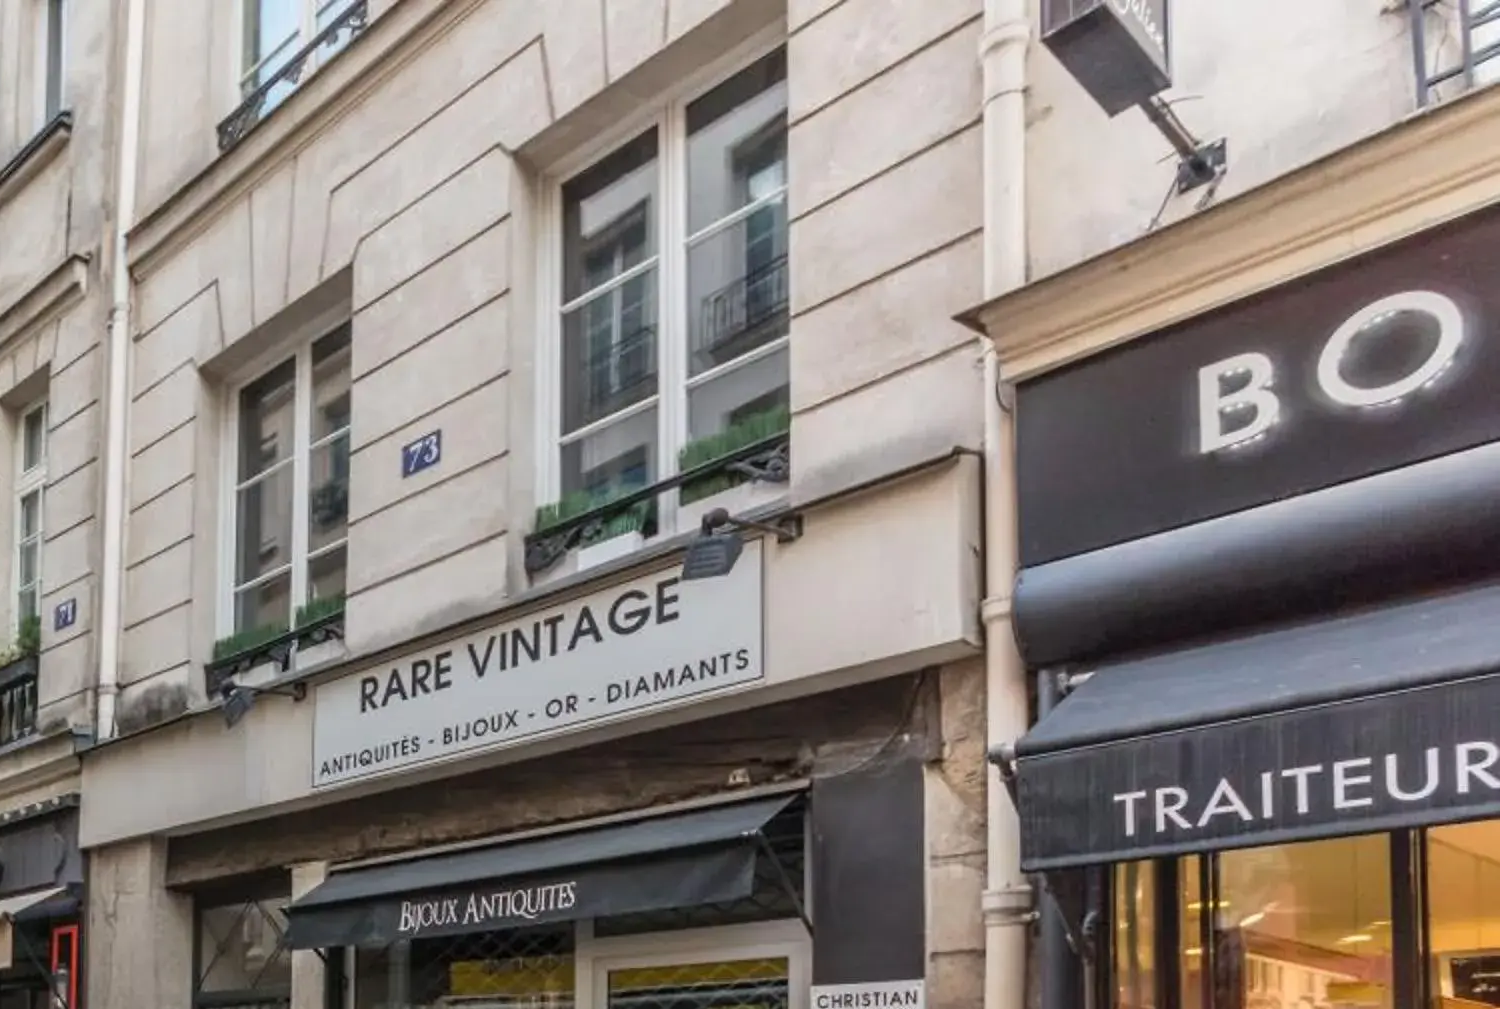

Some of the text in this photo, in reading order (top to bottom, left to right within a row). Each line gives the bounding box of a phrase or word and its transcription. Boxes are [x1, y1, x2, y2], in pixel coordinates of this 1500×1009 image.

[409, 436, 438, 473] 73
[58, 602, 73, 627] 71
[360, 577, 681, 715] RARE VINTAGE
[442, 709, 520, 747] BIJOUX
[544, 694, 579, 720] OR
[606, 648, 750, 704] DIAMANTS
[817, 991, 918, 1009] CHRISTIAN
